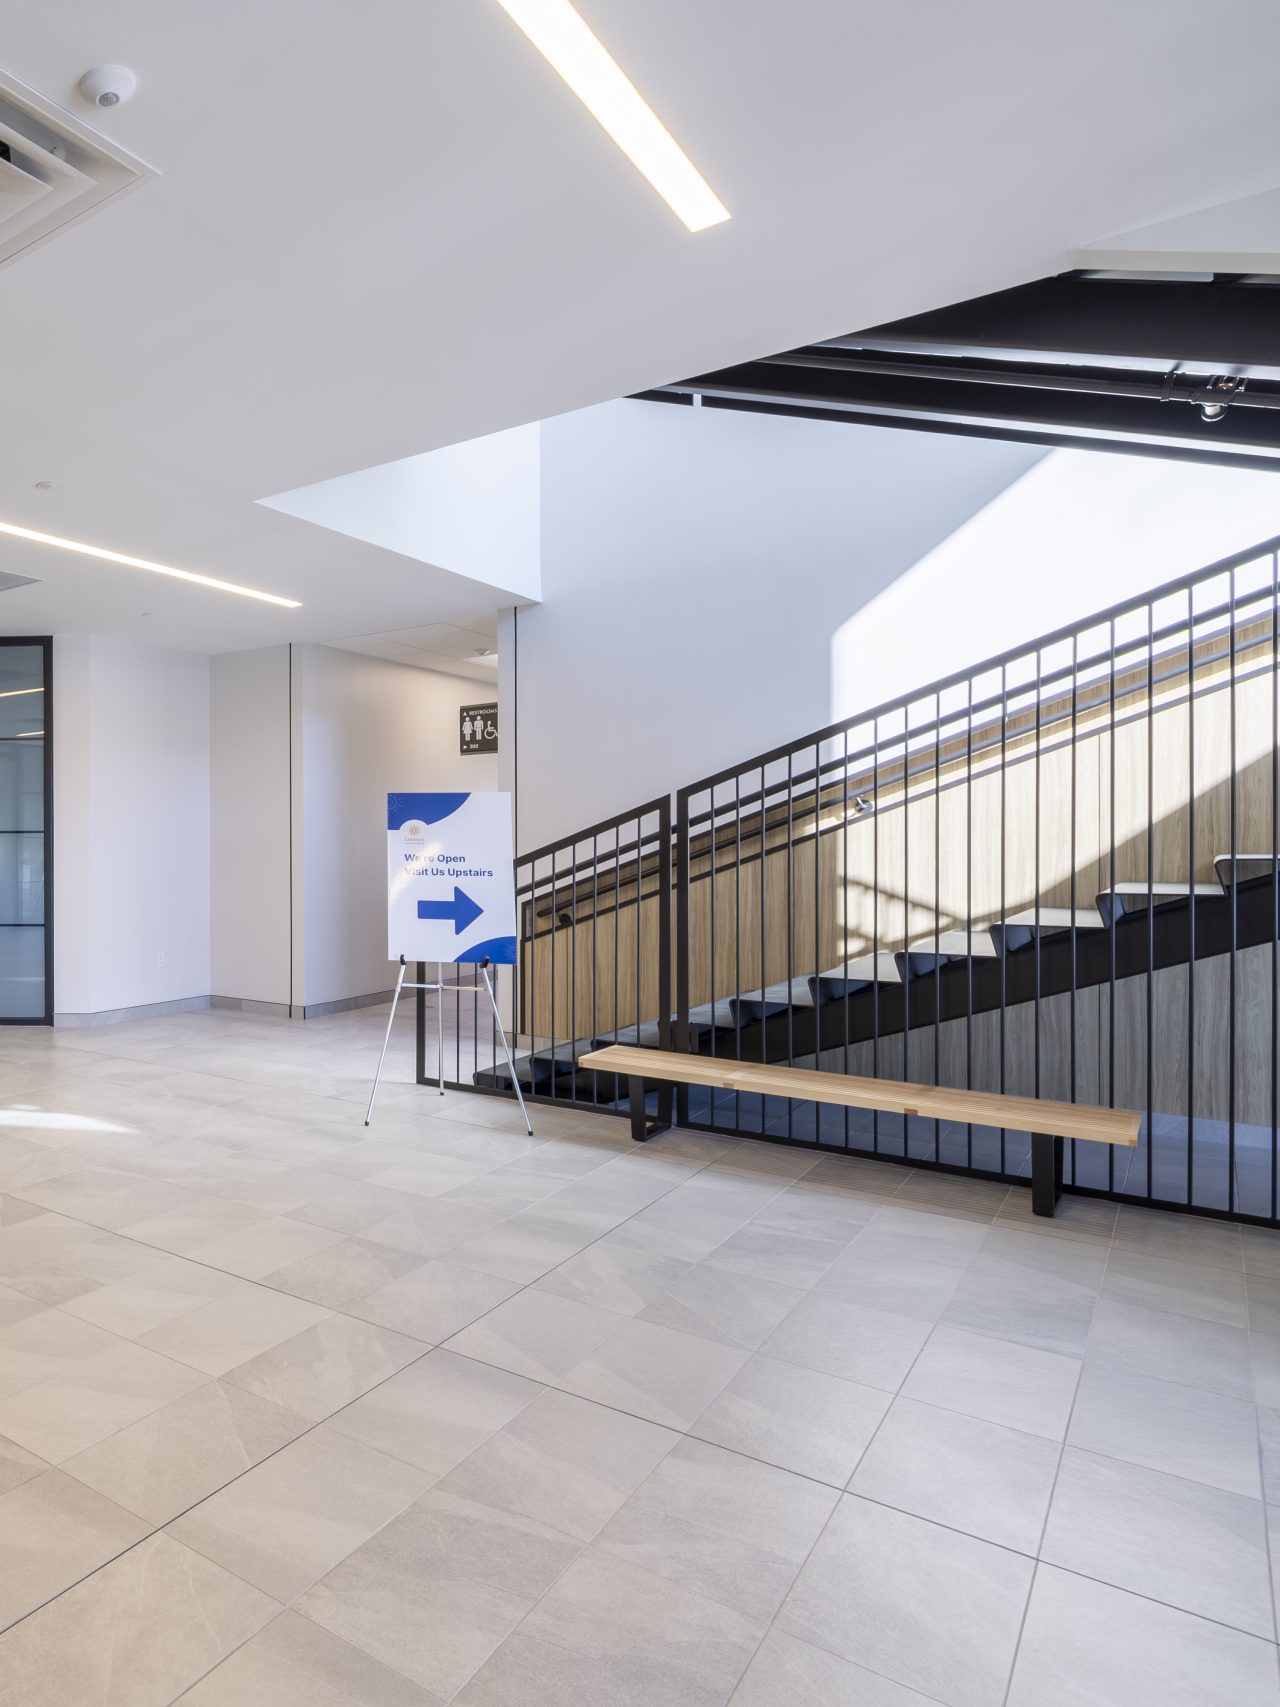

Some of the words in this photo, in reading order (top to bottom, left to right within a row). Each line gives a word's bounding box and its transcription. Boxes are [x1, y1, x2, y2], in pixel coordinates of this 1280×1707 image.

[437, 854, 466, 864] Open
[404, 867, 429, 876] Visit
[431, 868, 445, 876] Us
[447, 868, 493, 878] Upstairs
